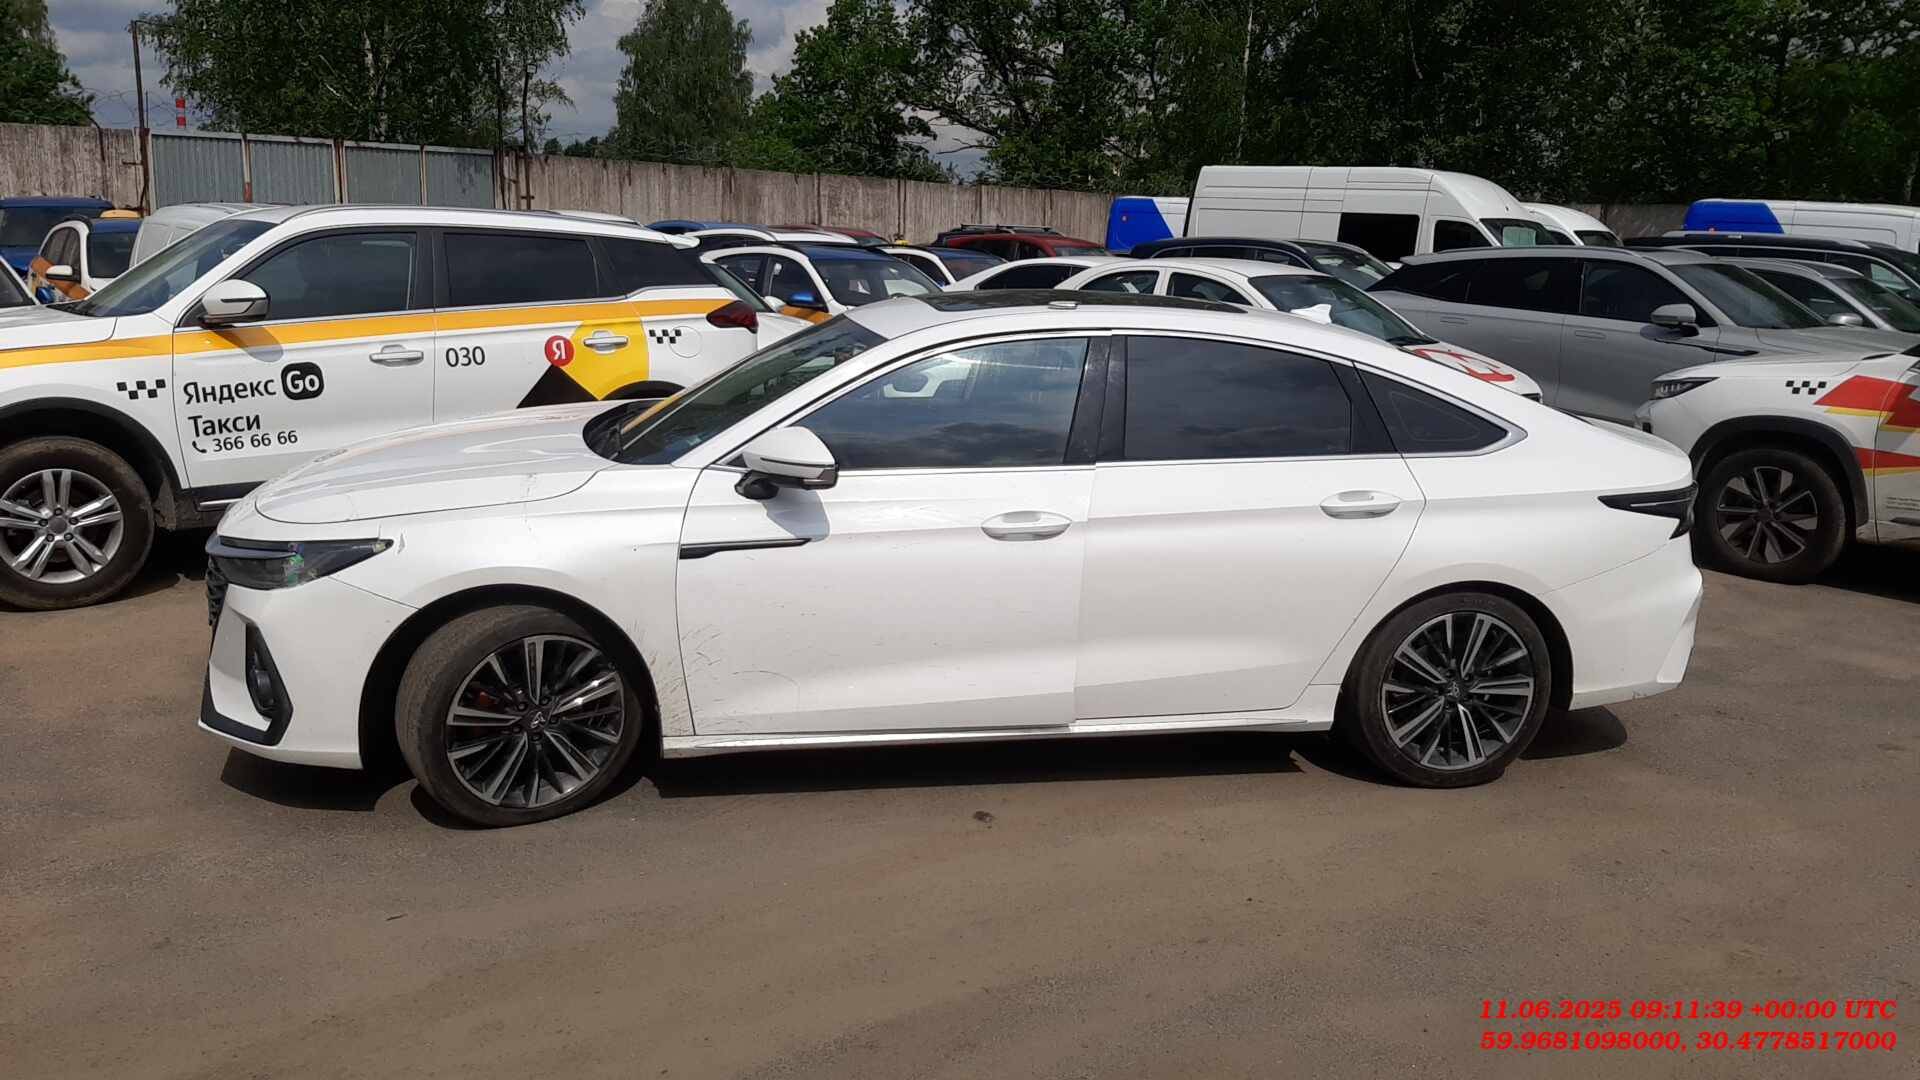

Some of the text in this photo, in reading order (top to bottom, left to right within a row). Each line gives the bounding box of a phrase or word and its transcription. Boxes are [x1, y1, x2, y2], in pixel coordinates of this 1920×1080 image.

[445, 346, 486, 367] 030
[552, 339, 567, 361] Я
[183, 370, 320, 405] Яндекс Go
[187, 414, 261, 438] Такси
[212, 430, 298, 452] 366 66 66
